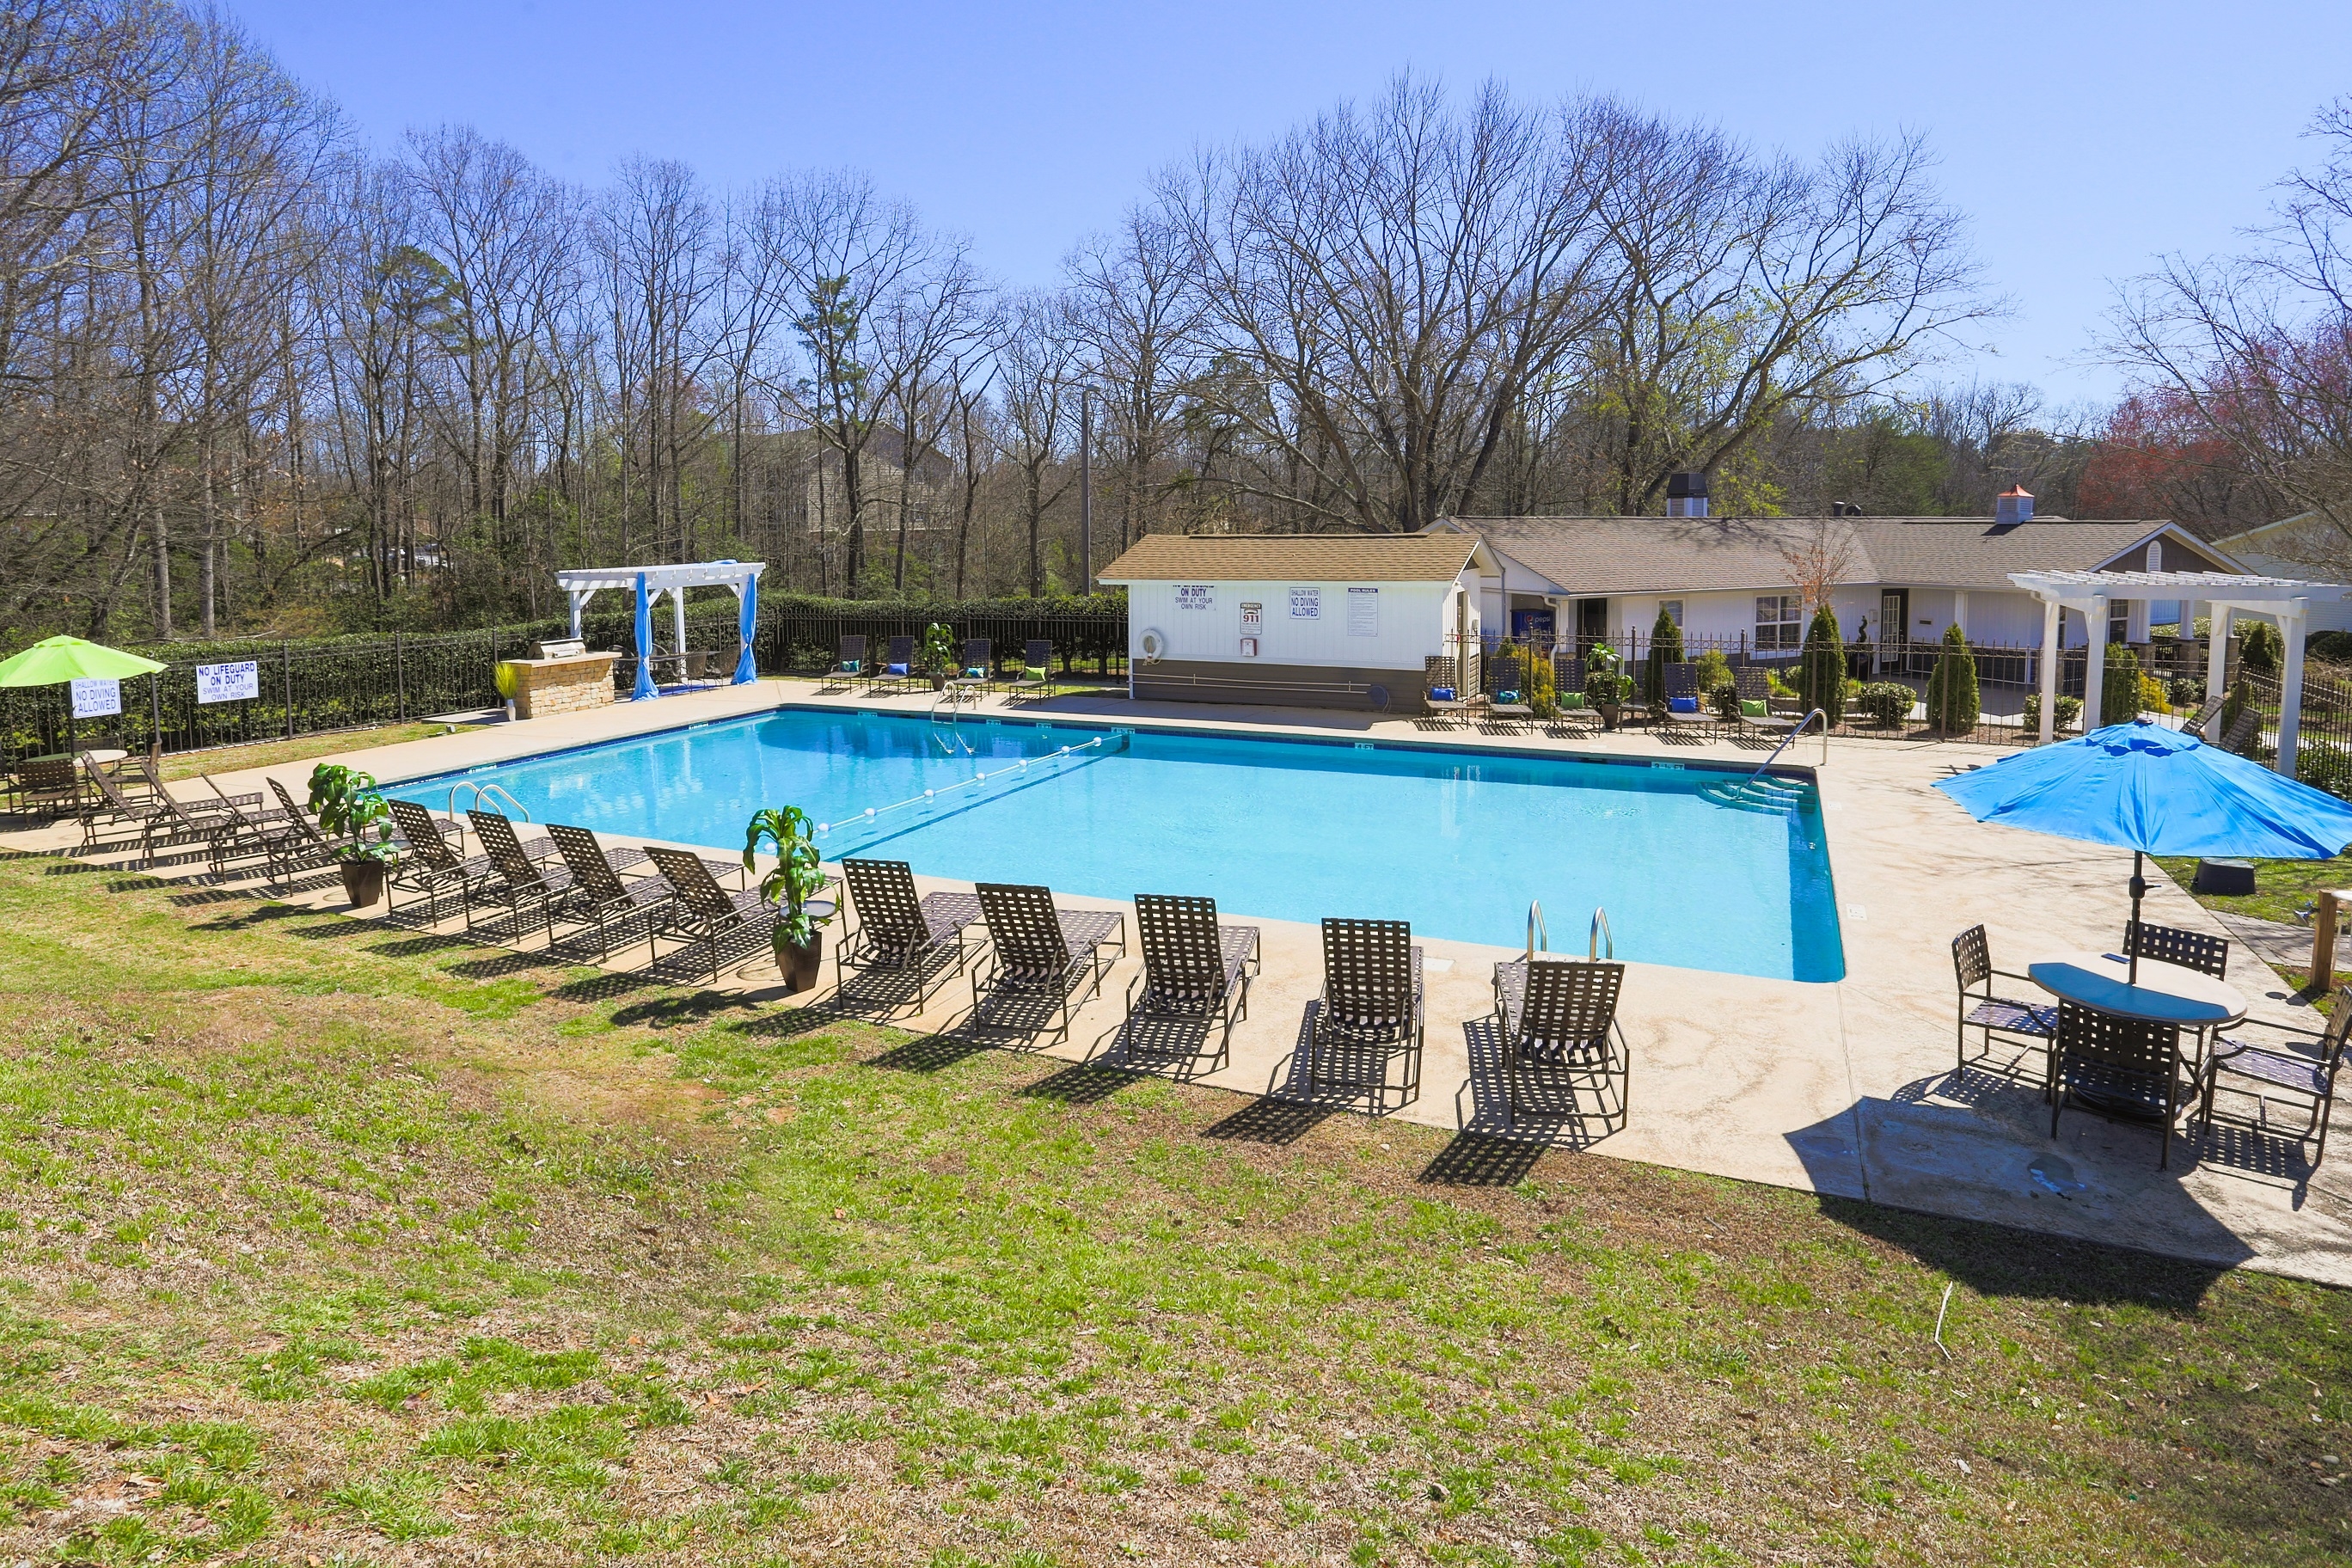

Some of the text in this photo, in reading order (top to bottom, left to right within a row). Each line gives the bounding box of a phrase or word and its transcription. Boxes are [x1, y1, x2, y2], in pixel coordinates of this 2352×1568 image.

[1180, 588, 1207, 597] ON DUTY
[1291, 597, 1319, 607] NO DIVING
[1292, 607, 1319, 616] ALLOWED
[1243, 614, 1259, 622] 911
[1534, 615, 1551, 623] pepsi
[199, 663, 255, 677] NO LIFEGUARD
[75, 680, 97, 689] SHALLOW
[211, 674, 245, 686] ON DUTY
[76, 688, 116, 701] NO DIVING
[78, 699, 116, 713] ALLOWED
